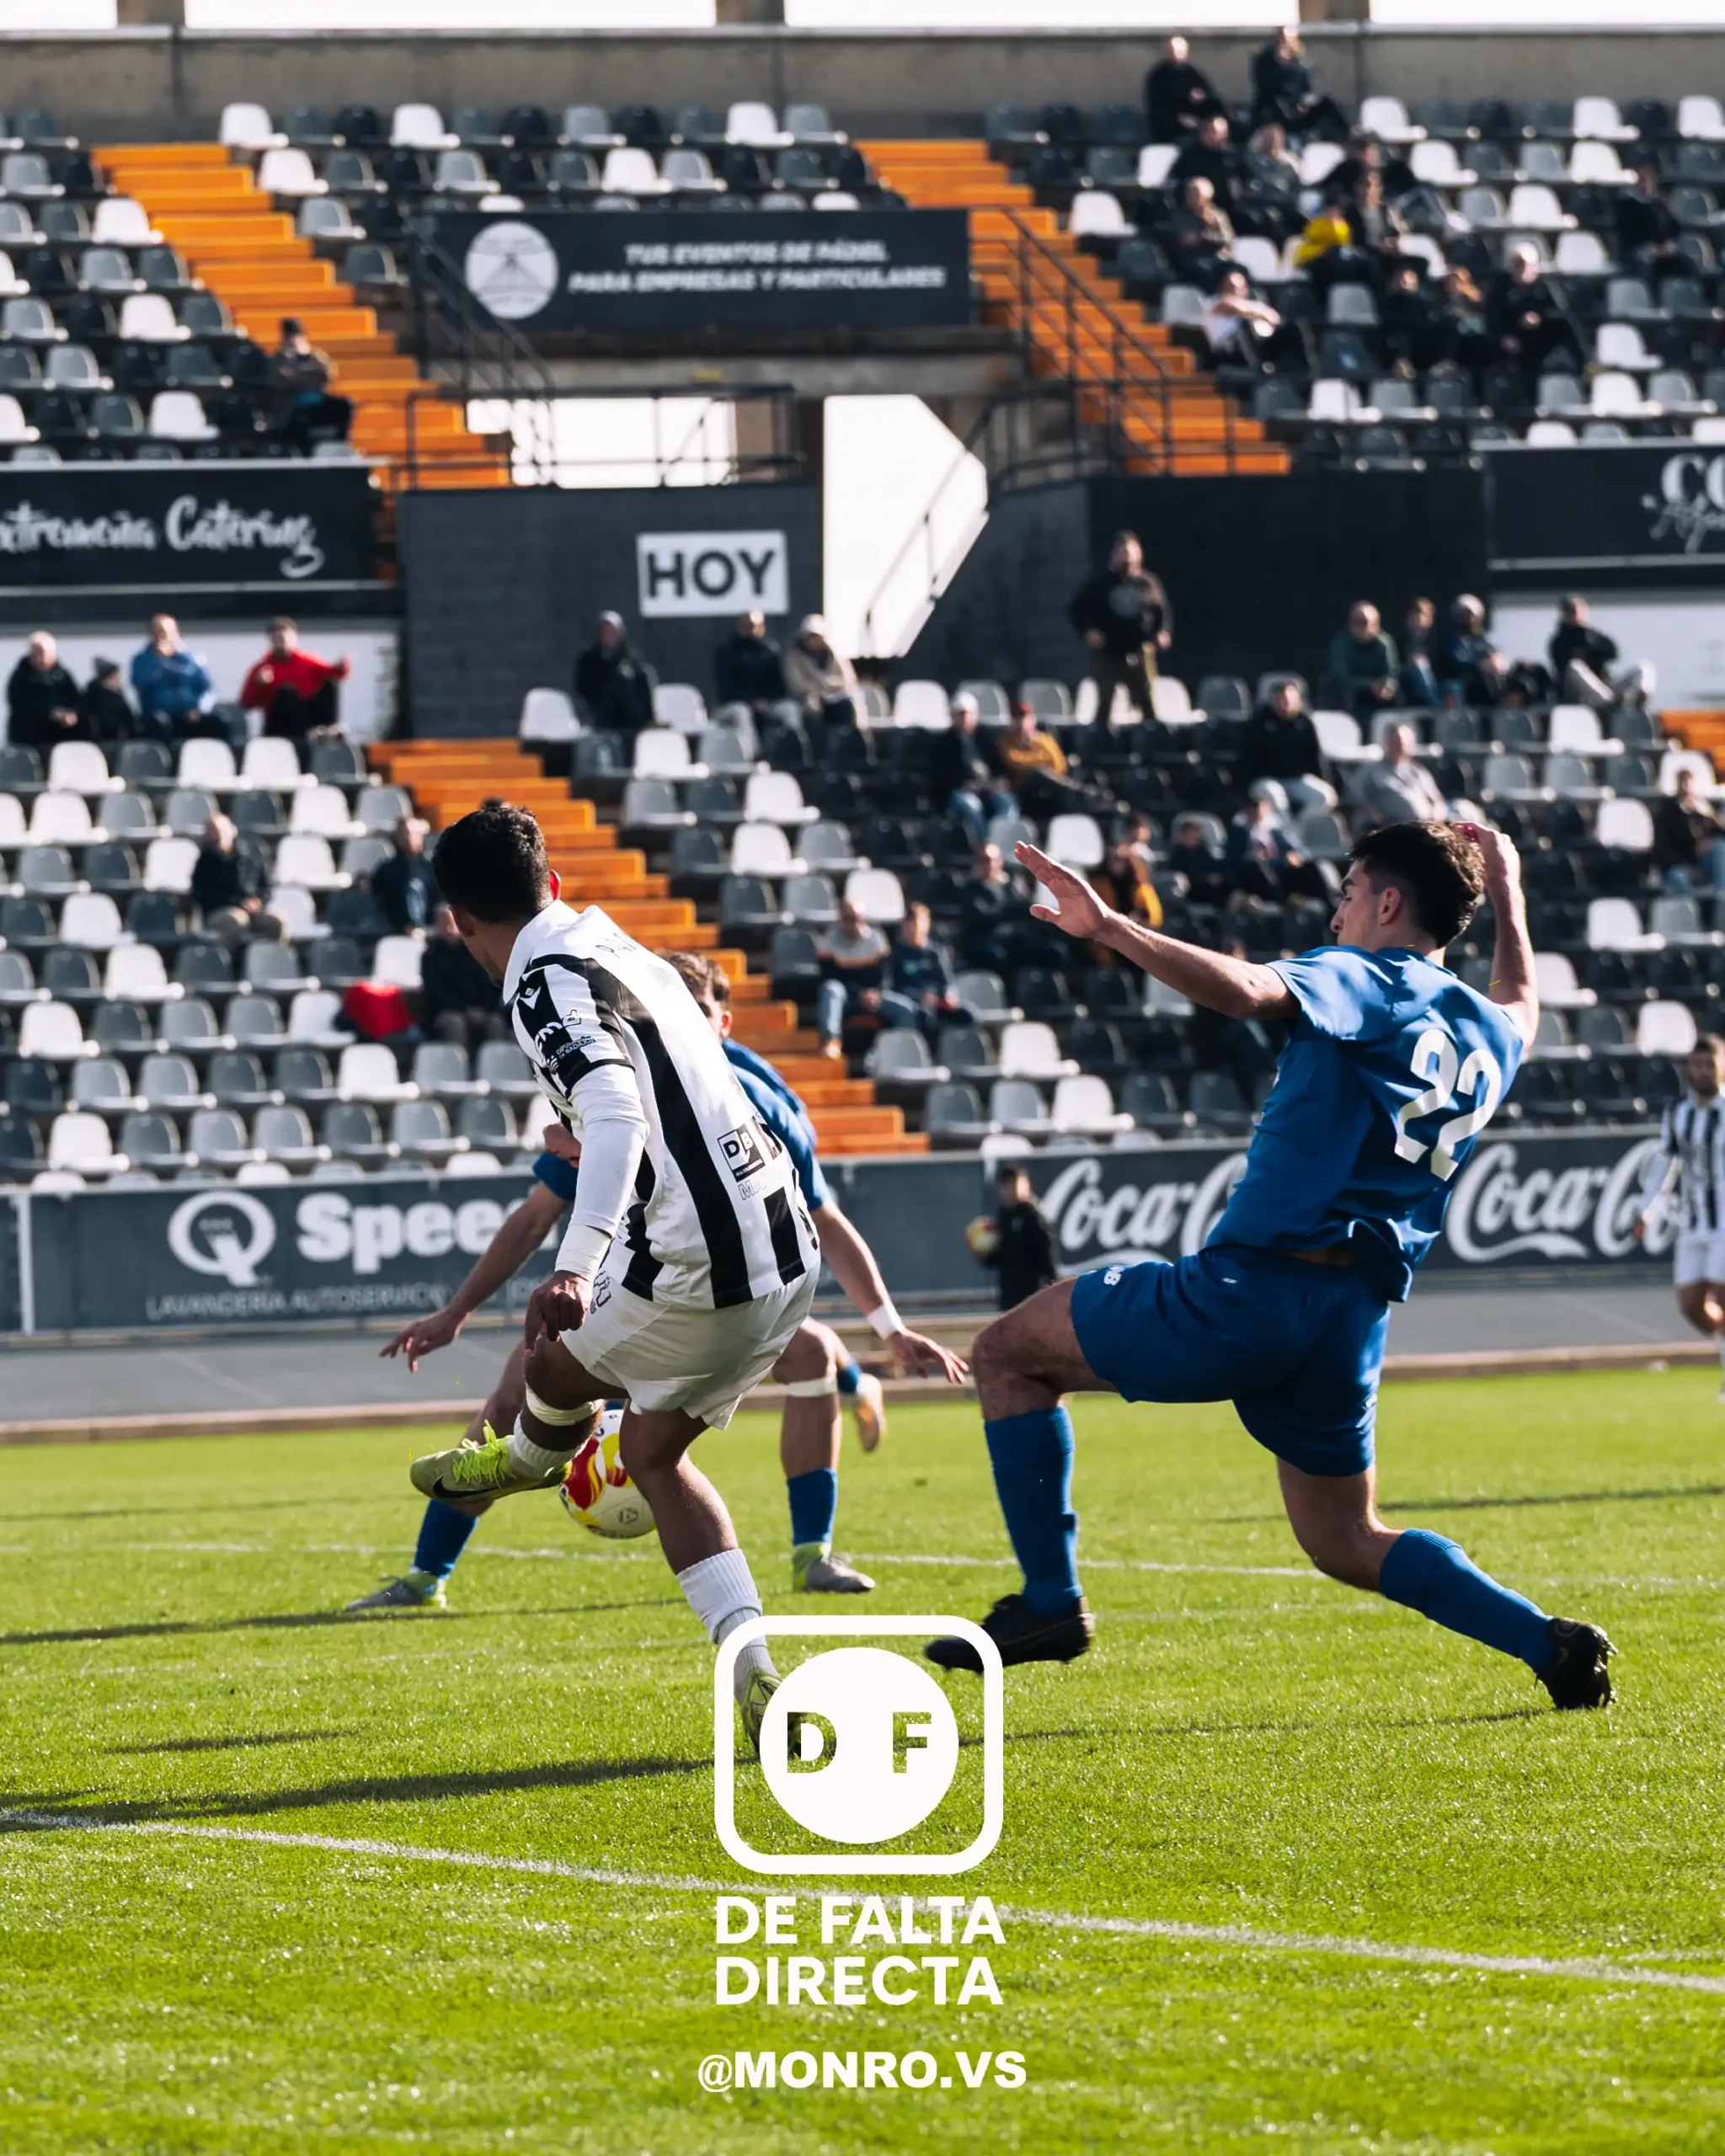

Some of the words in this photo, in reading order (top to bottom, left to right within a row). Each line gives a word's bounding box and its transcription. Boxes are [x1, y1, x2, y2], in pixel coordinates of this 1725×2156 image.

[626, 243, 668, 265] TUS
[674, 242, 776, 264] EVENTOS
[782, 240, 809, 262] DE
[569, 272, 630, 294] PARA
[636, 269, 756, 291] EMPRESAS
[760, 268, 774, 290] Y
[777, 265, 945, 290] PARTICULARES
[165, 494, 324, 578] Catering
[648, 549, 774, 598] HOY
[1395, 1028, 1501, 1182] 22
